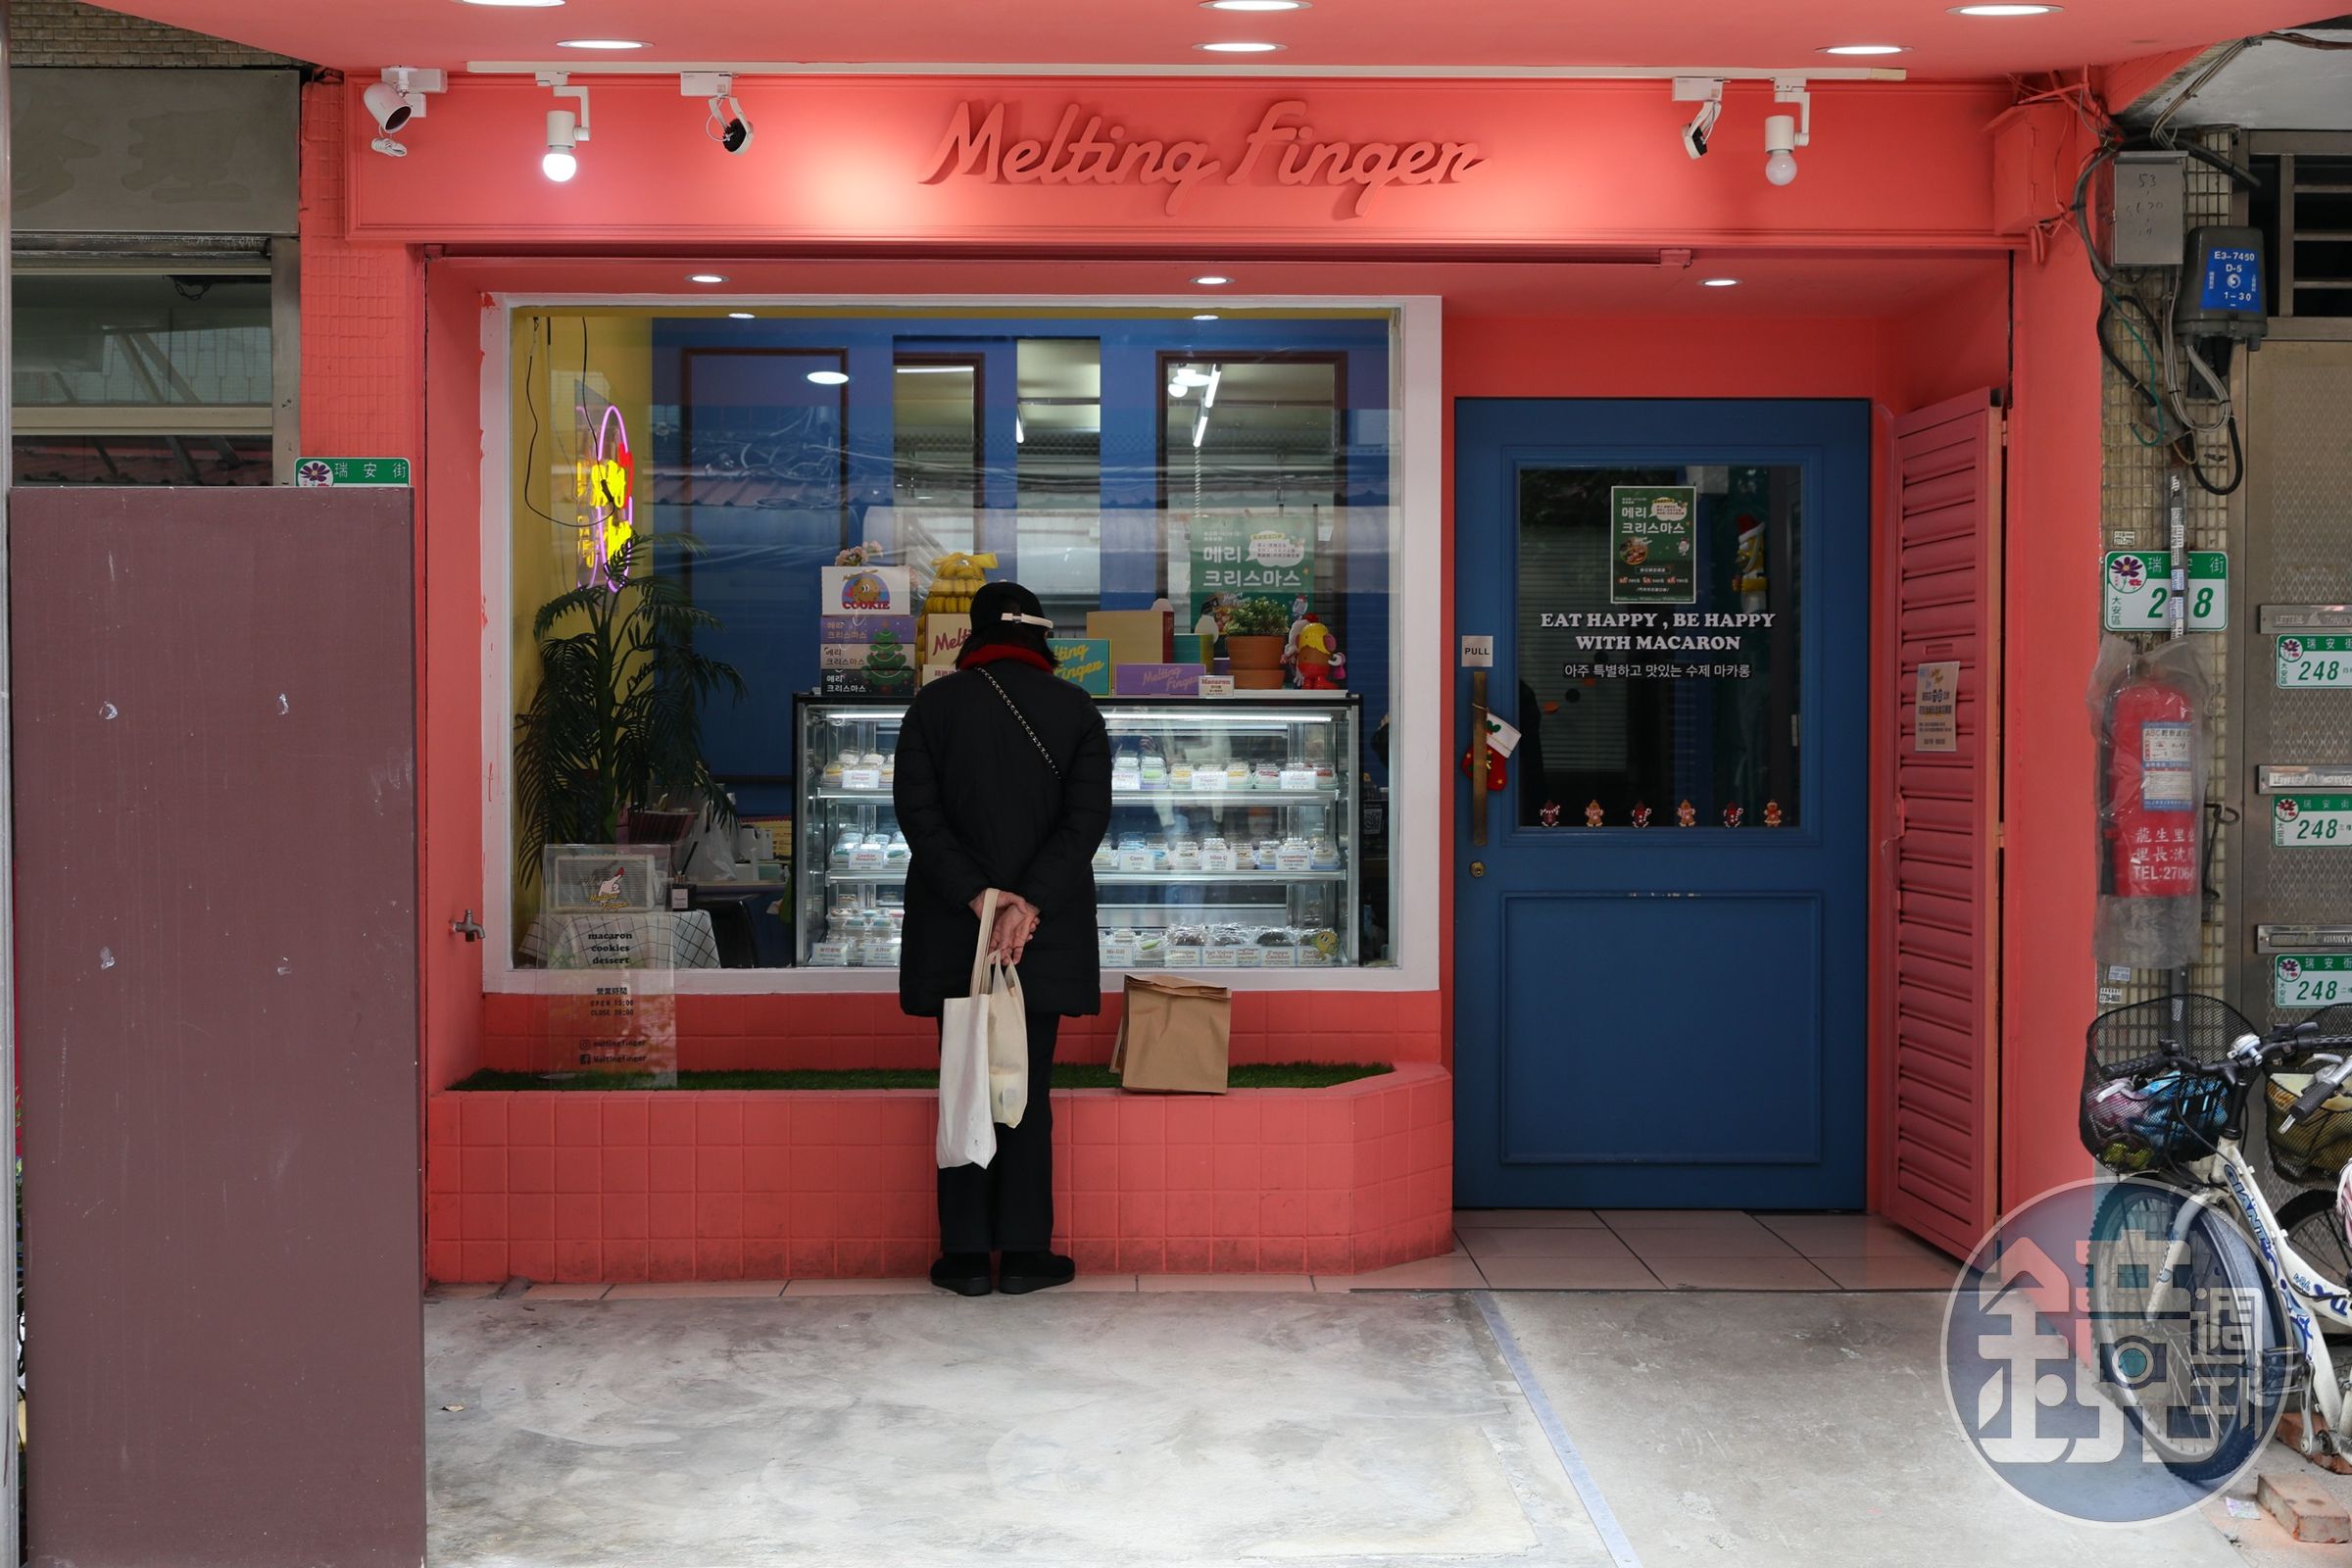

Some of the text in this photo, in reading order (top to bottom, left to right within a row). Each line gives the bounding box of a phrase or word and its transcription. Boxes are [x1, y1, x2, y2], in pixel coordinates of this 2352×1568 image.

[917, 100, 1220, 218] Melting
[2226, 264, 2243, 272] D-5
[334, 462, 406, 478] 瑞安街
[1621, 507, 1647, 518] 메리
[1621, 522, 1686, 534] 크리스마스
[1202, 546, 1242, 564] 메리
[2147, 556, 2225, 573] 瑞街
[1202, 569, 1301, 587] 크리스마스
[842, 600, 891, 610] COOKIE
[2111, 596, 2122, 625] 大安區
[2147, 587, 2214, 618] 28
[1540, 612, 1583, 627] EAT
[1587, 612, 1659, 627] HAPPY
[1673, 612, 1699, 627] BE
[1704, 612, 1777, 627] HAPPY
[1575, 636, 1741, 650] WITH MACARON
[1464, 647, 1491, 656] PULL
[1564, 664, 1751, 678] 아주 특별하고 맛있는 수제 마카롱
[2298, 661, 2339, 681] 248
[2297, 819, 2338, 839] 248
[596, 987, 628, 996] 營業時間
[2296, 980, 2338, 1001] 248
[2224, 1164, 2272, 1247] GIANT
